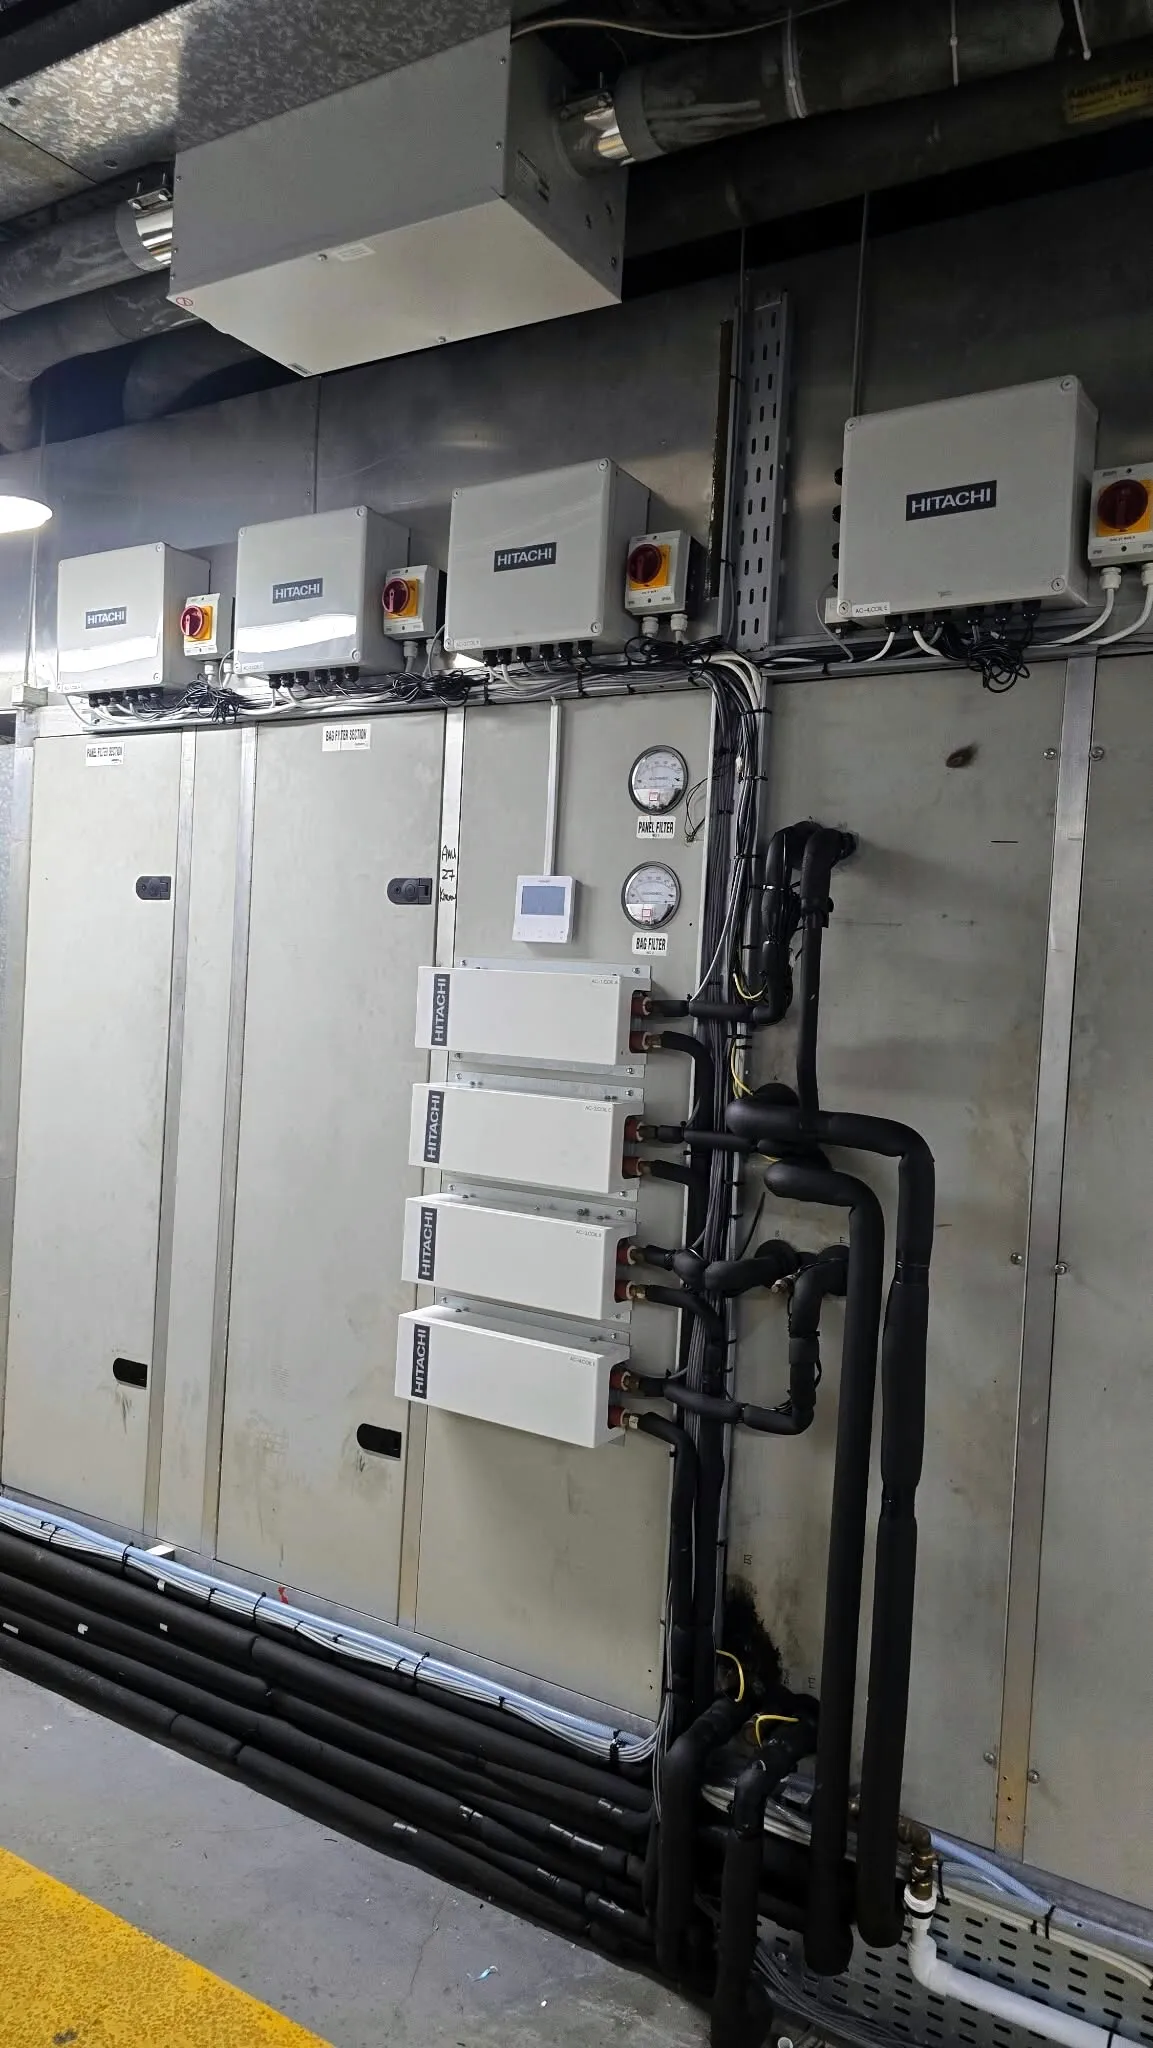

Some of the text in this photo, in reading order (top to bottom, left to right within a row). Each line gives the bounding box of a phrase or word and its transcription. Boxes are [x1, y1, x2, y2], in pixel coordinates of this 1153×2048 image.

[911, 487, 992, 514] HITACHI
[497, 547, 553, 567] HITACHI
[275, 583, 321, 600] HITACHI
[87, 610, 125, 625] HITACHI
[638, 821, 674, 834] PANEL FILTER
[441, 868, 455, 881] 27
[636, 937, 666, 951] BAG FILTER
[434, 978, 447, 1042] HITACHI
[426, 1094, 441, 1159] HITACHI
[421, 1211, 434, 1276] HITACHI
[414, 1328, 427, 1394] HITACHI
